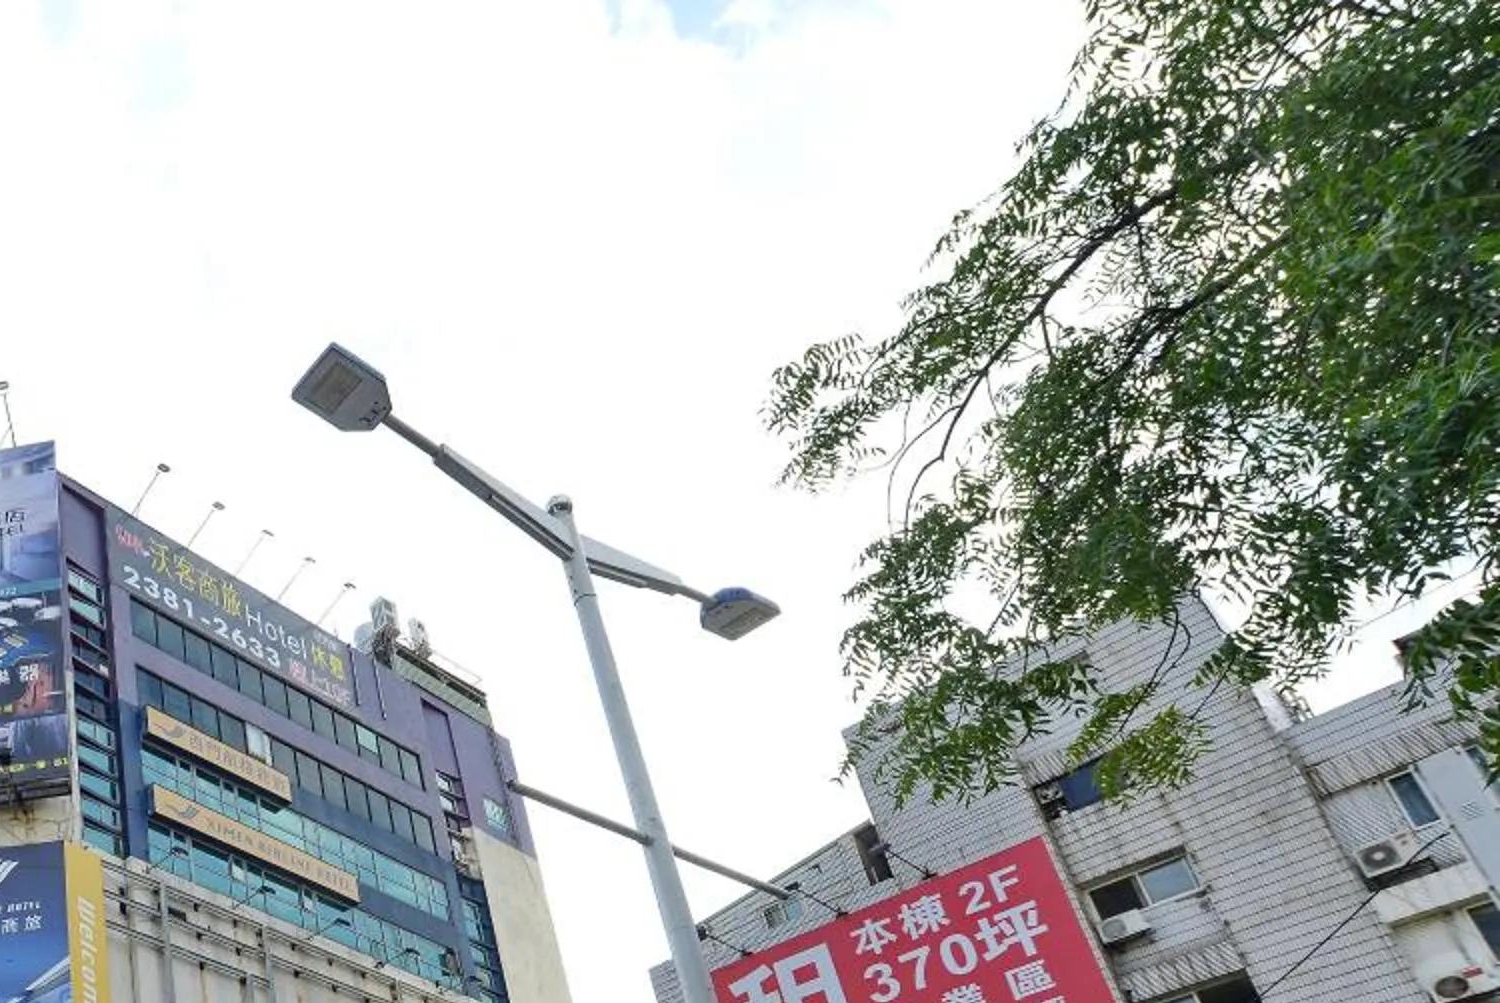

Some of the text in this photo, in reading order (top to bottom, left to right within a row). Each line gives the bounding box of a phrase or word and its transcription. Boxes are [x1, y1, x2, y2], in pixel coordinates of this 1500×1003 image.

[122, 565, 281, 668] 2381-2633
[245, 603, 308, 660] Hotel
[850, 864, 1020, 956] 本棟 2F
